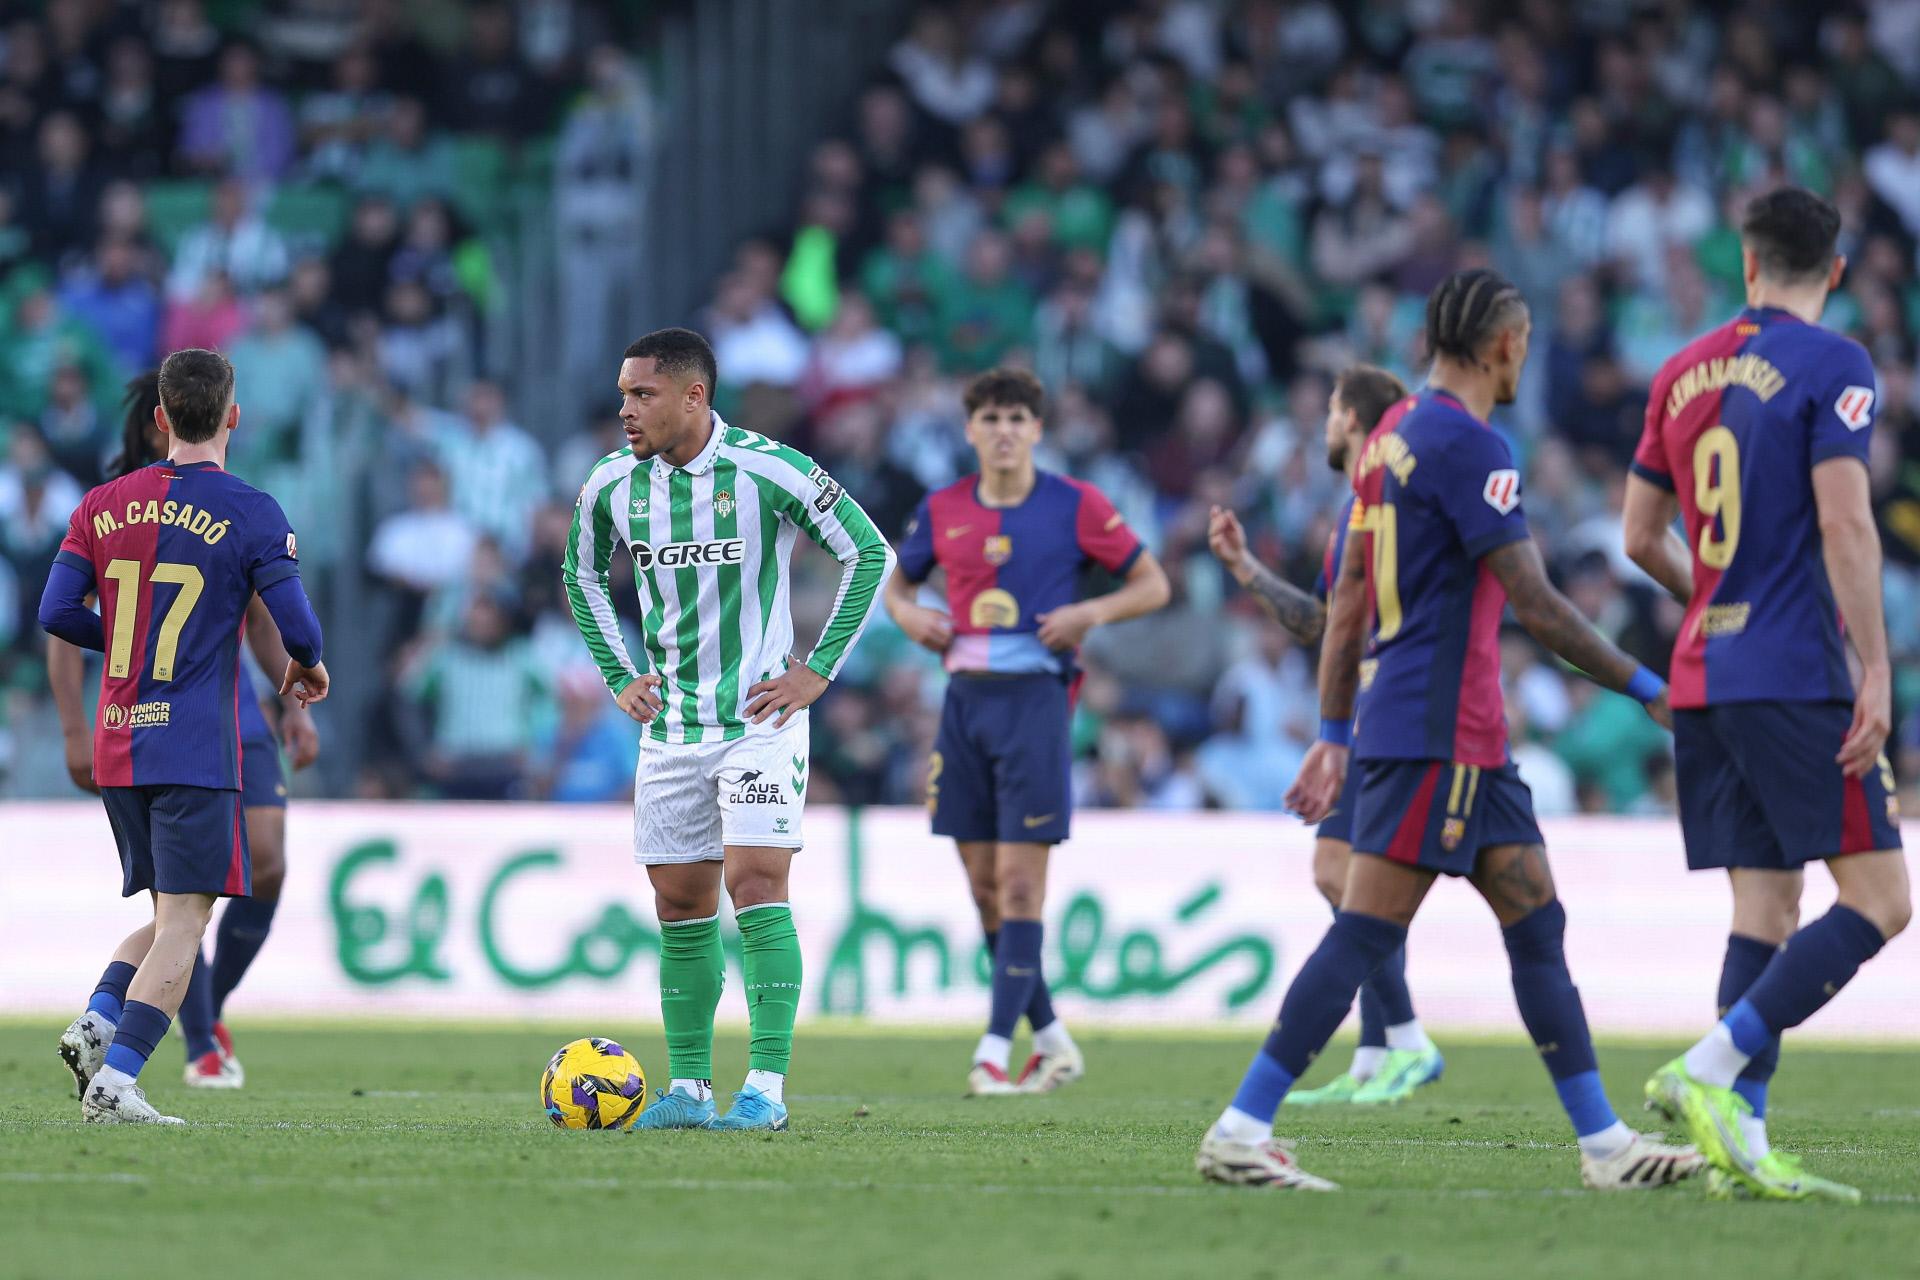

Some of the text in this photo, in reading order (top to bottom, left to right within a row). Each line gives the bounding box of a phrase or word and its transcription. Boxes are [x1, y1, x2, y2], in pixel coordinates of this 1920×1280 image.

[1693, 425, 1741, 569] 9
[93, 500, 232, 545] M. CASADÓ
[657, 541, 743, 566] GREE
[104, 558, 205, 682] 17
[130, 701, 171, 715] UNHCR
[128, 711, 170, 725] ACNUR
[746, 783, 780, 793] AUS
[729, 793, 788, 805] GLOBAL
